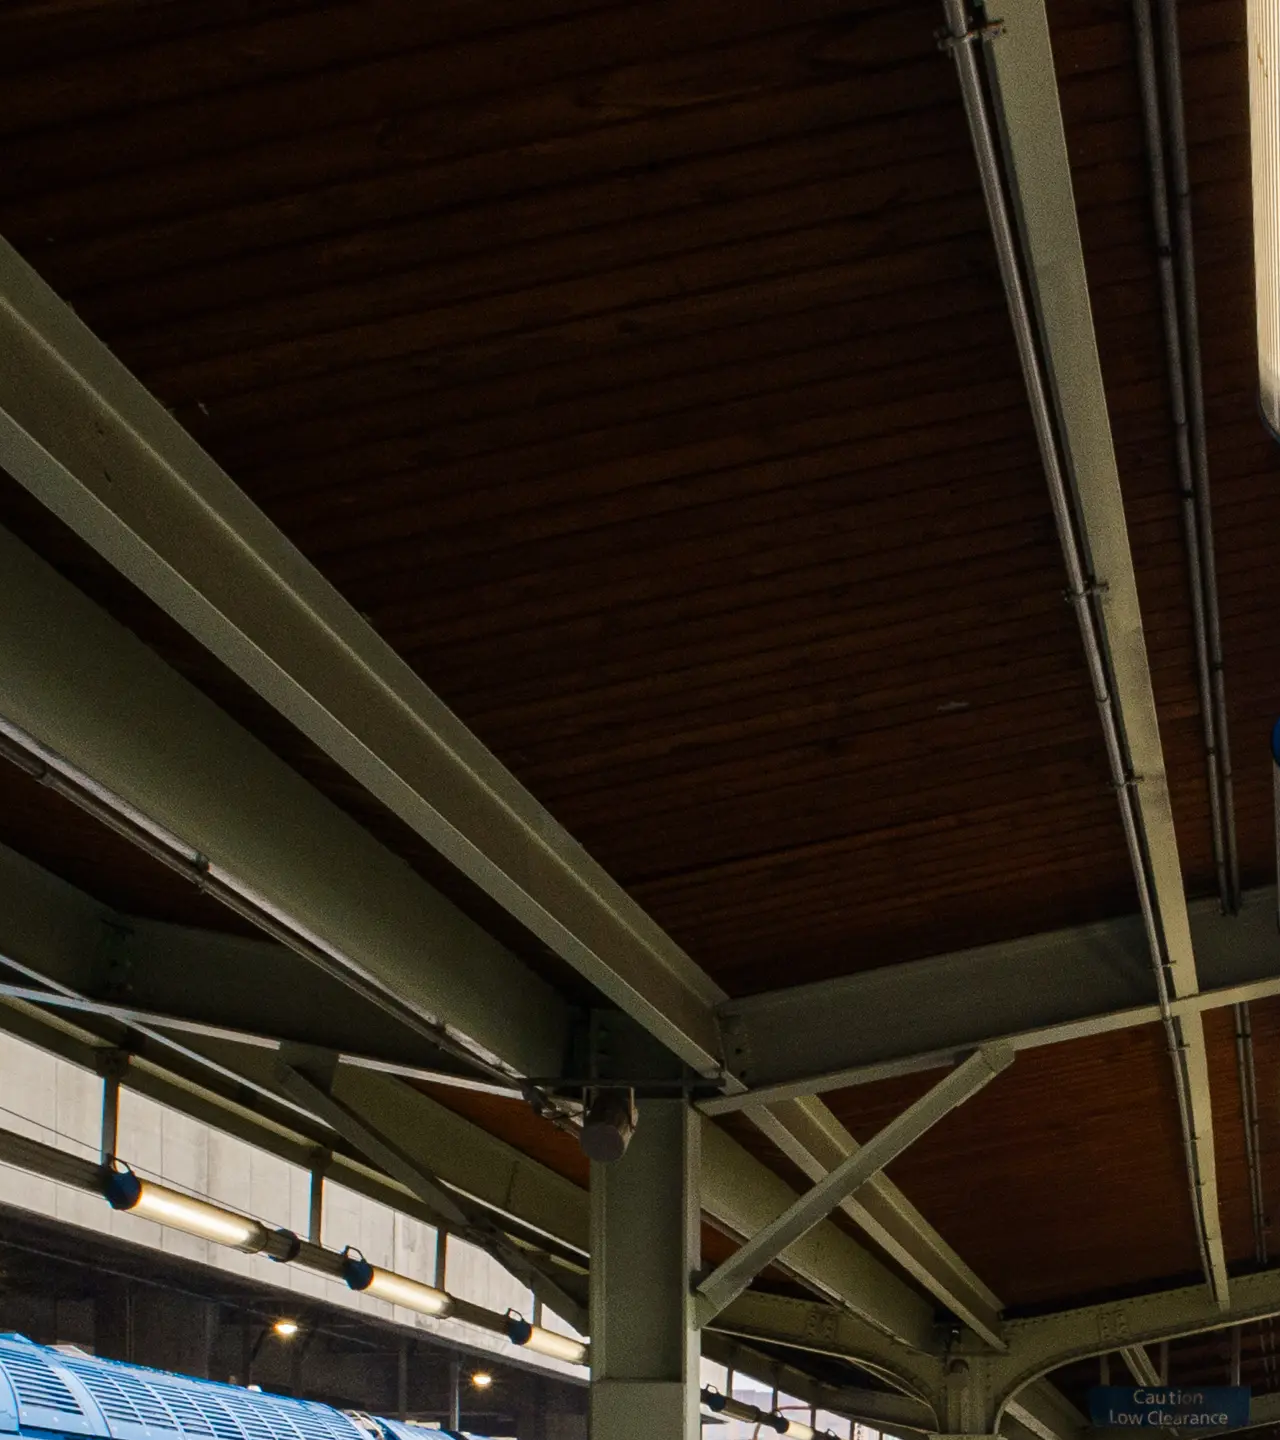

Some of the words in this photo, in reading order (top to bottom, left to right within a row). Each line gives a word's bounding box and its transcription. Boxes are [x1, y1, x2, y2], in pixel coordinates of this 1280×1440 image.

[1133, 1389, 1203, 1405] Caution
[1109, 1409, 1143, 1425] Low
[1147, 1410, 1228, 1425] Clearance
